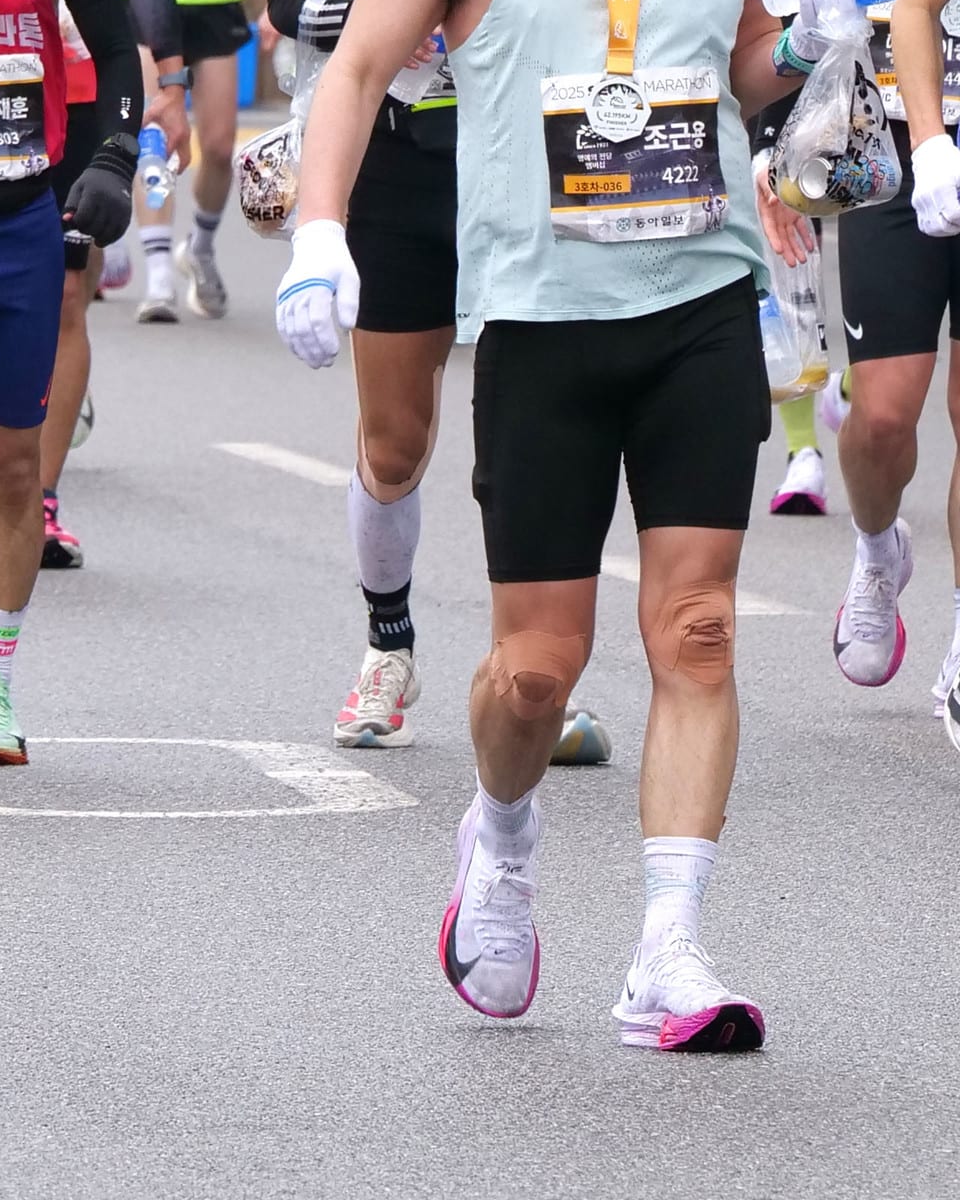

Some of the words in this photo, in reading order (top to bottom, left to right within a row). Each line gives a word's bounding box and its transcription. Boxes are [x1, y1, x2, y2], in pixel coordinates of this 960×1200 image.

[551, 86, 586, 101] 2025
[643, 120, 707, 151] 조근용
[662, 165, 700, 185] 4222
[574, 181, 623, 193] 3호차-036
[634, 214, 685, 230] 동아일보
